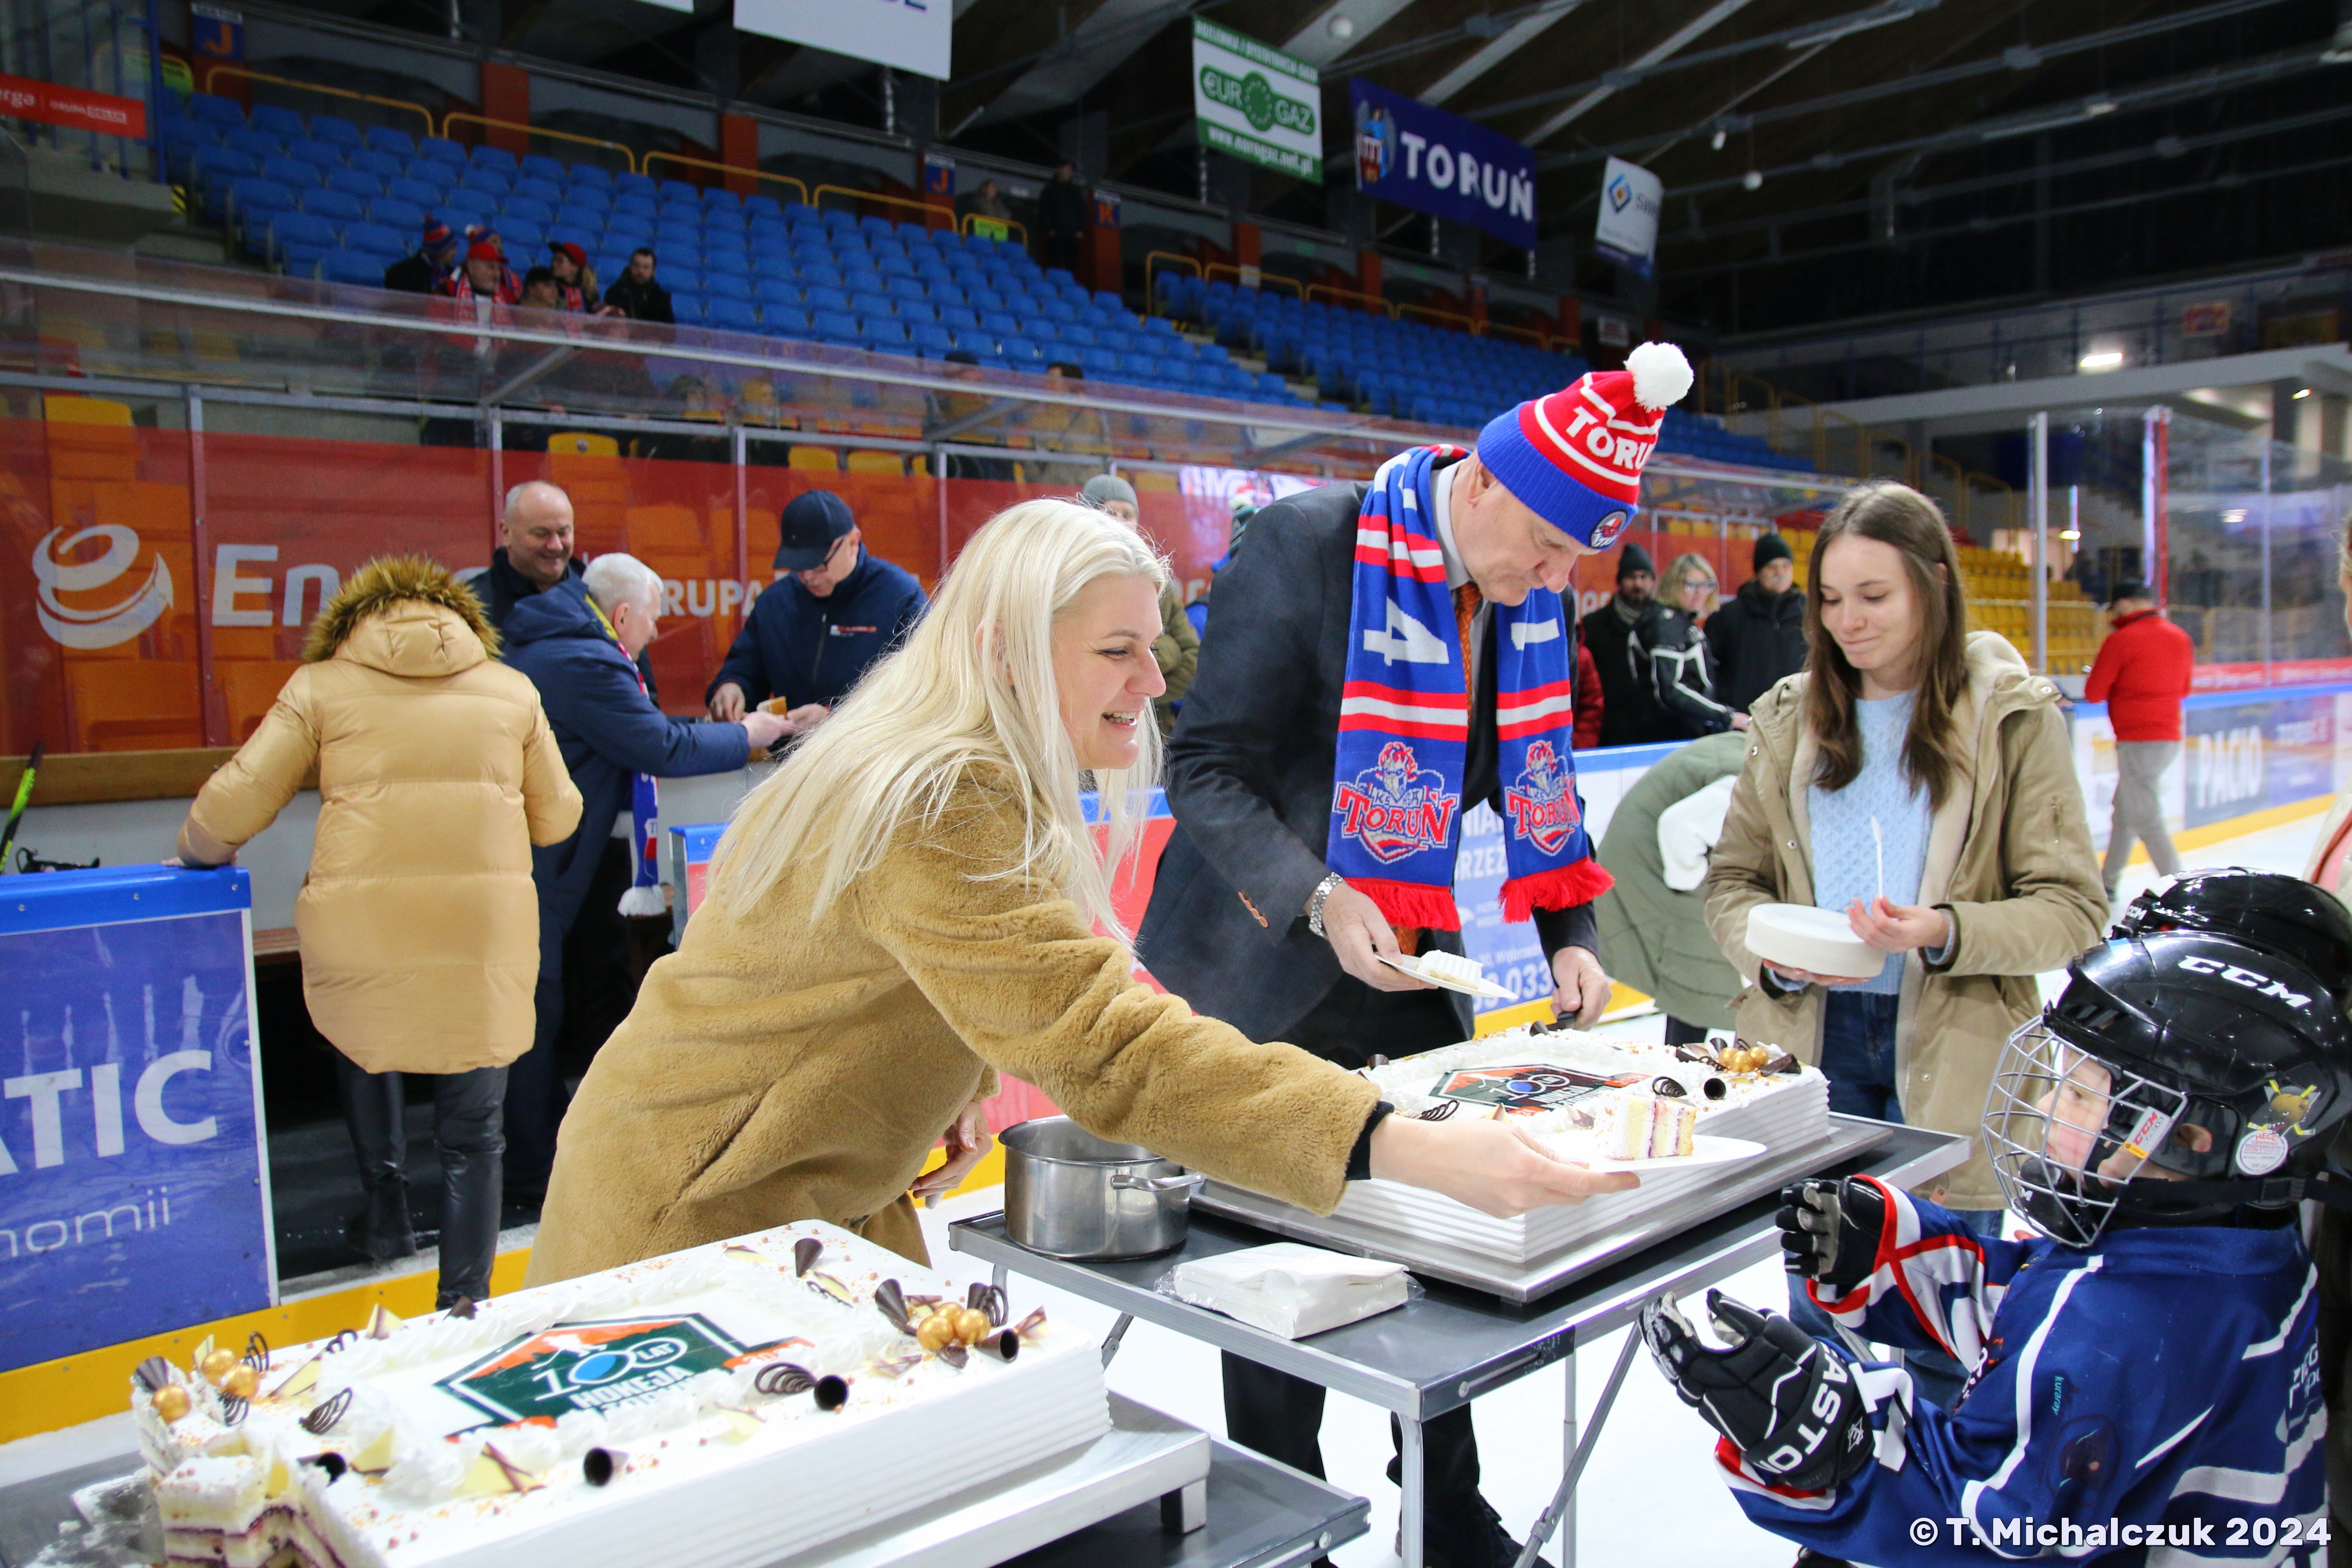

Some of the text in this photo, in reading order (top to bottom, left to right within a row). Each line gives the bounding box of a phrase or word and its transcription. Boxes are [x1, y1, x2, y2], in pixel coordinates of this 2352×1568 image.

[1400, 130, 1534, 223] TORUŃ
[2177, 955, 2312, 1008] CCM
[0, 1050, 218, 1175] TIC
[638, 1344, 674, 1360] LAT
[569, 1365, 695, 1409] HOKEJA
